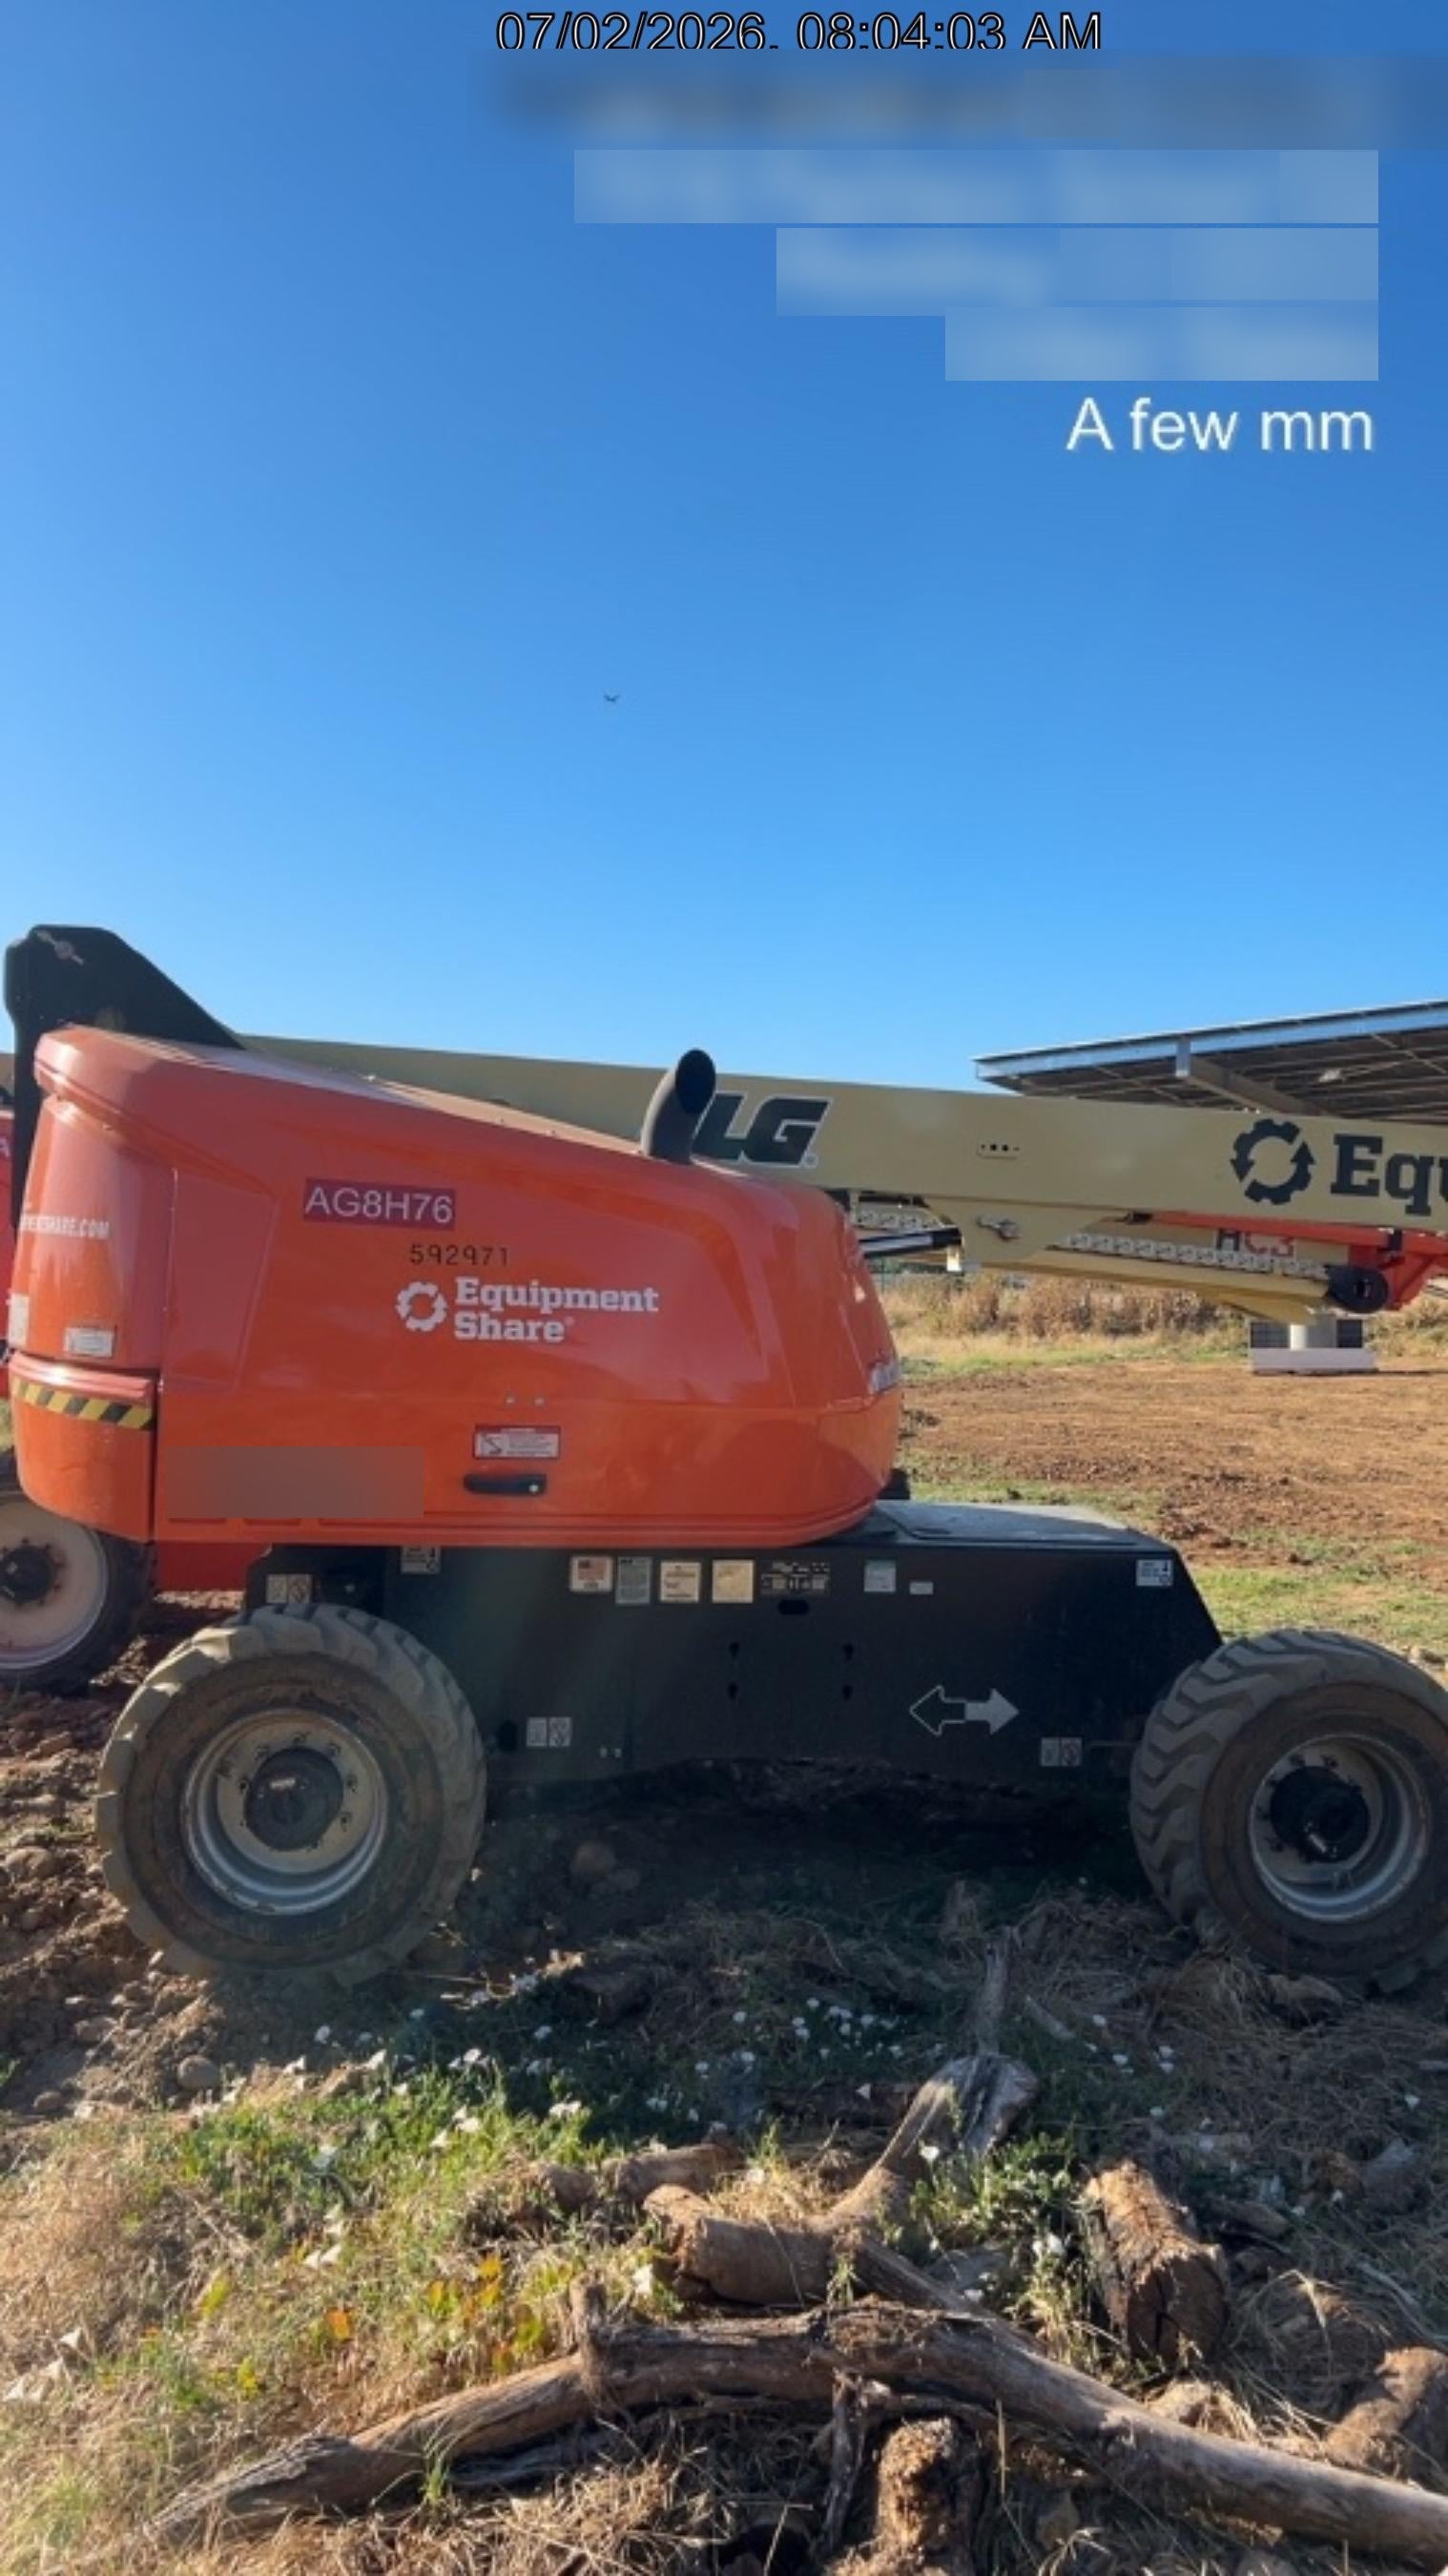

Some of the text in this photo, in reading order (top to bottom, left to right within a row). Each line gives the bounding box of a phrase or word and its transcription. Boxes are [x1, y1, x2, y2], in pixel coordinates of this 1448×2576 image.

[692, 1091, 833, 1168] LG
[1330, 1133, 1448, 1216] Eq
[304, 1185, 454, 1224] AG8H76
[409, 1244, 509, 1266] 592971
[455, 1276, 659, 1314] Equipment
[454, 1310, 566, 1343] Share
